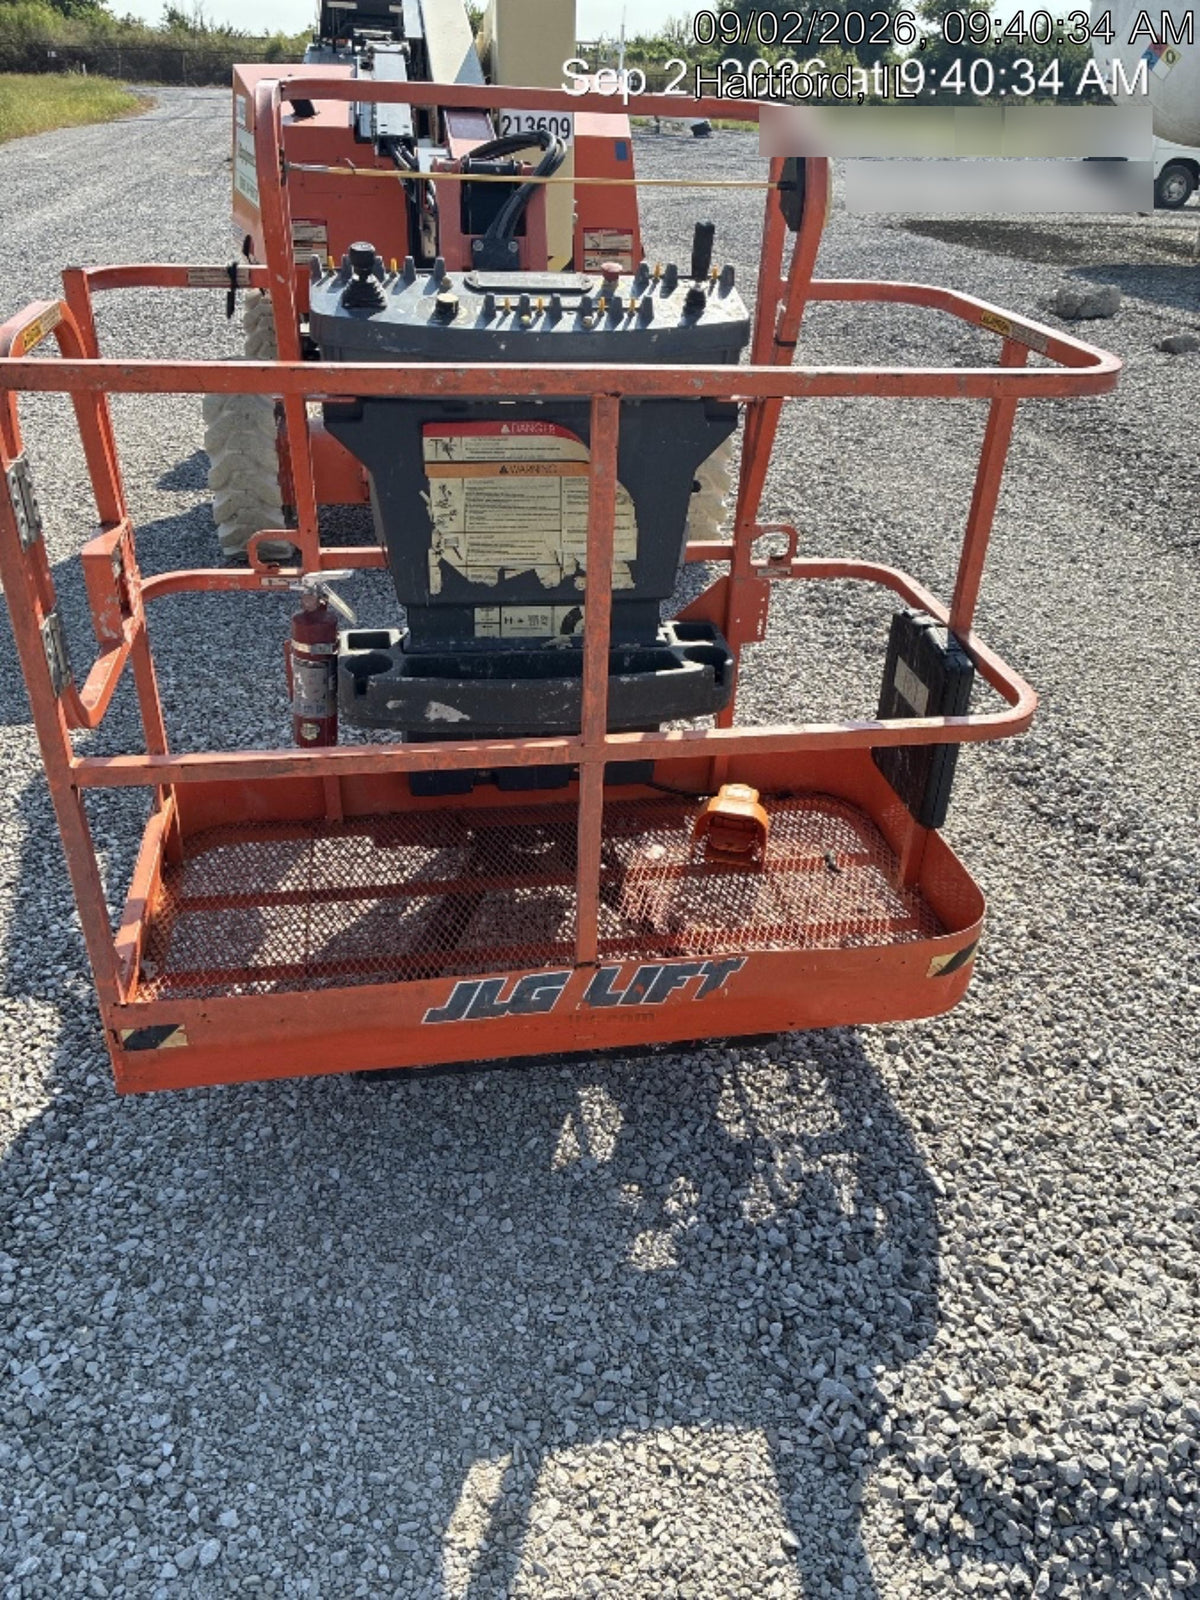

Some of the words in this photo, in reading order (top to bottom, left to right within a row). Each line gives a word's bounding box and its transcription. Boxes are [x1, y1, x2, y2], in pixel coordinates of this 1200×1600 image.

[1166, 49, 1176, 65] 0
[501, 115, 571, 140] 213609
[511, 423, 557, 434] DANGER
[422, 970, 573, 1025] JLG
[583, 956, 749, 1009] LIFT
